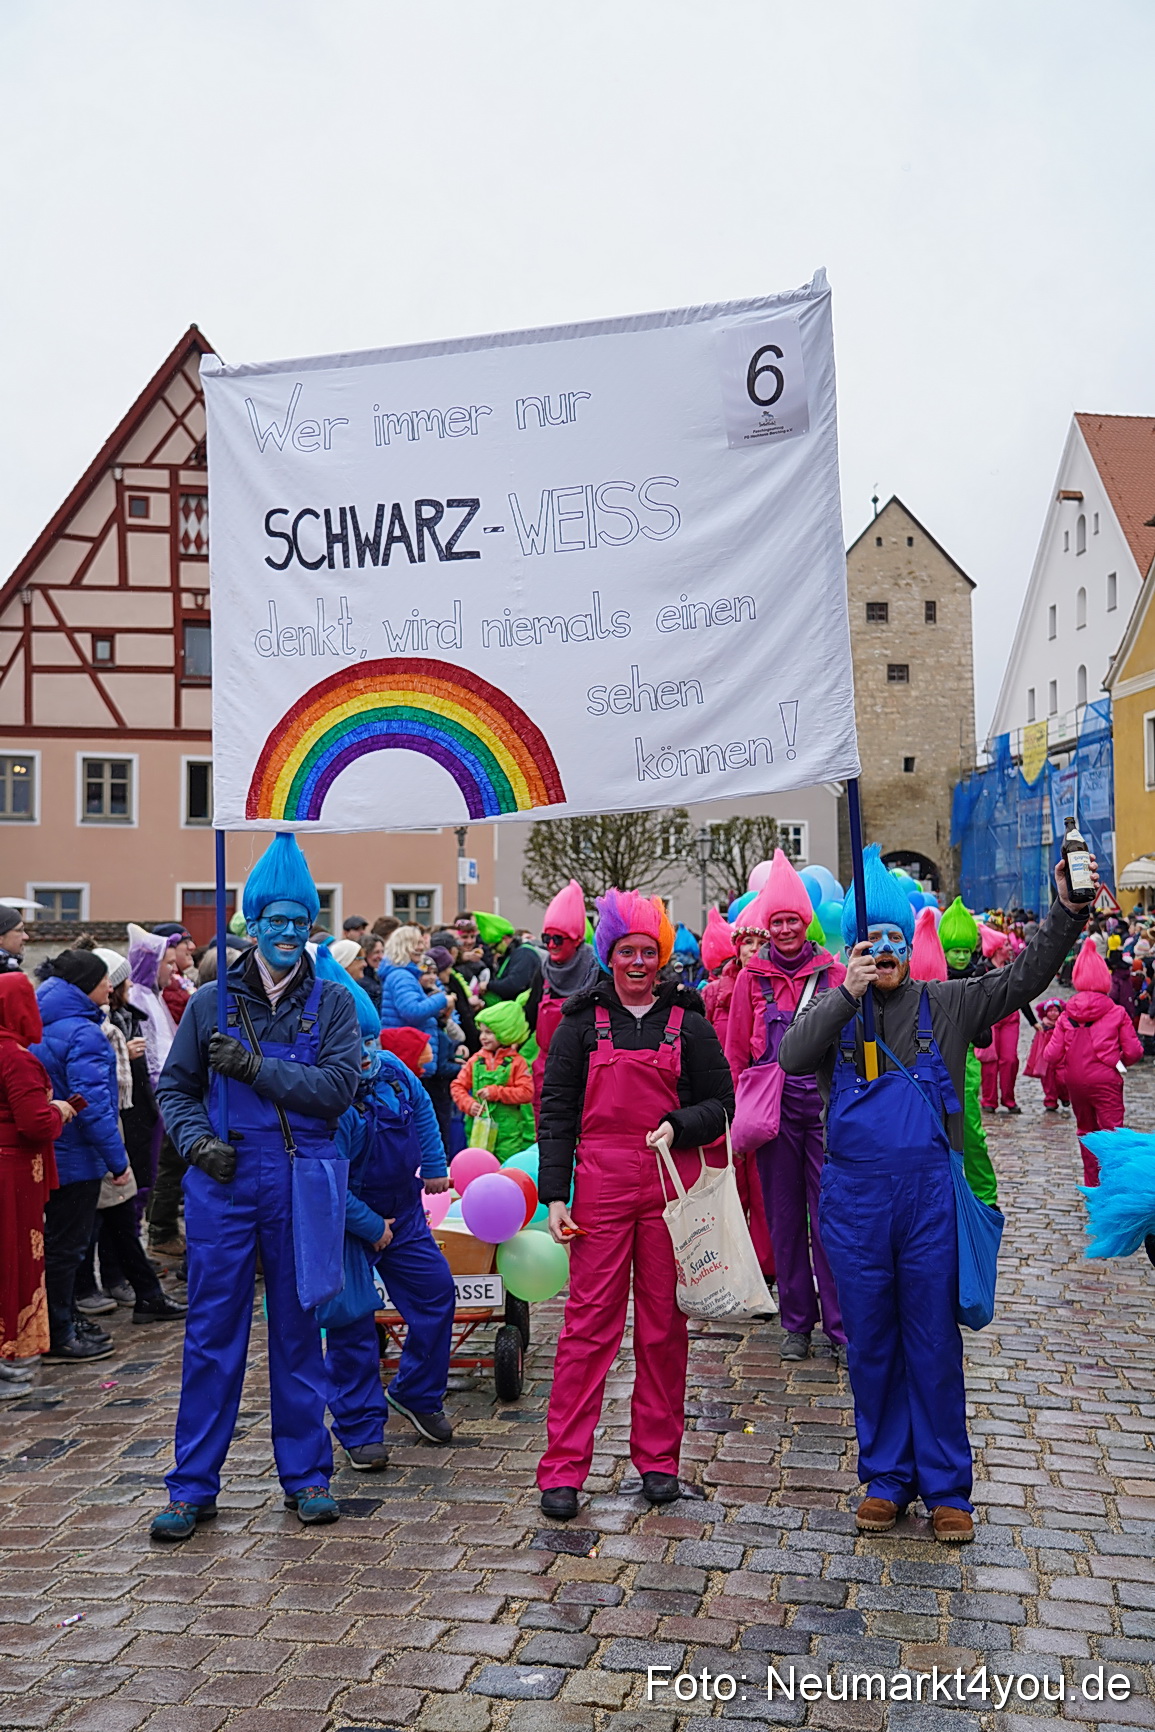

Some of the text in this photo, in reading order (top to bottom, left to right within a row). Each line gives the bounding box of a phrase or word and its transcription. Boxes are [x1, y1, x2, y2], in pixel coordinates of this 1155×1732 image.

[746, 344, 785, 407] 6
[245, 383, 592, 454] Wer immer nur
[264, 475, 682, 572] SCHWARZ-WEISS
[254, 590, 757, 661] denkt, wird niemals einen
[586, 664, 704, 717] sehen
[634, 699, 801, 783] können!
